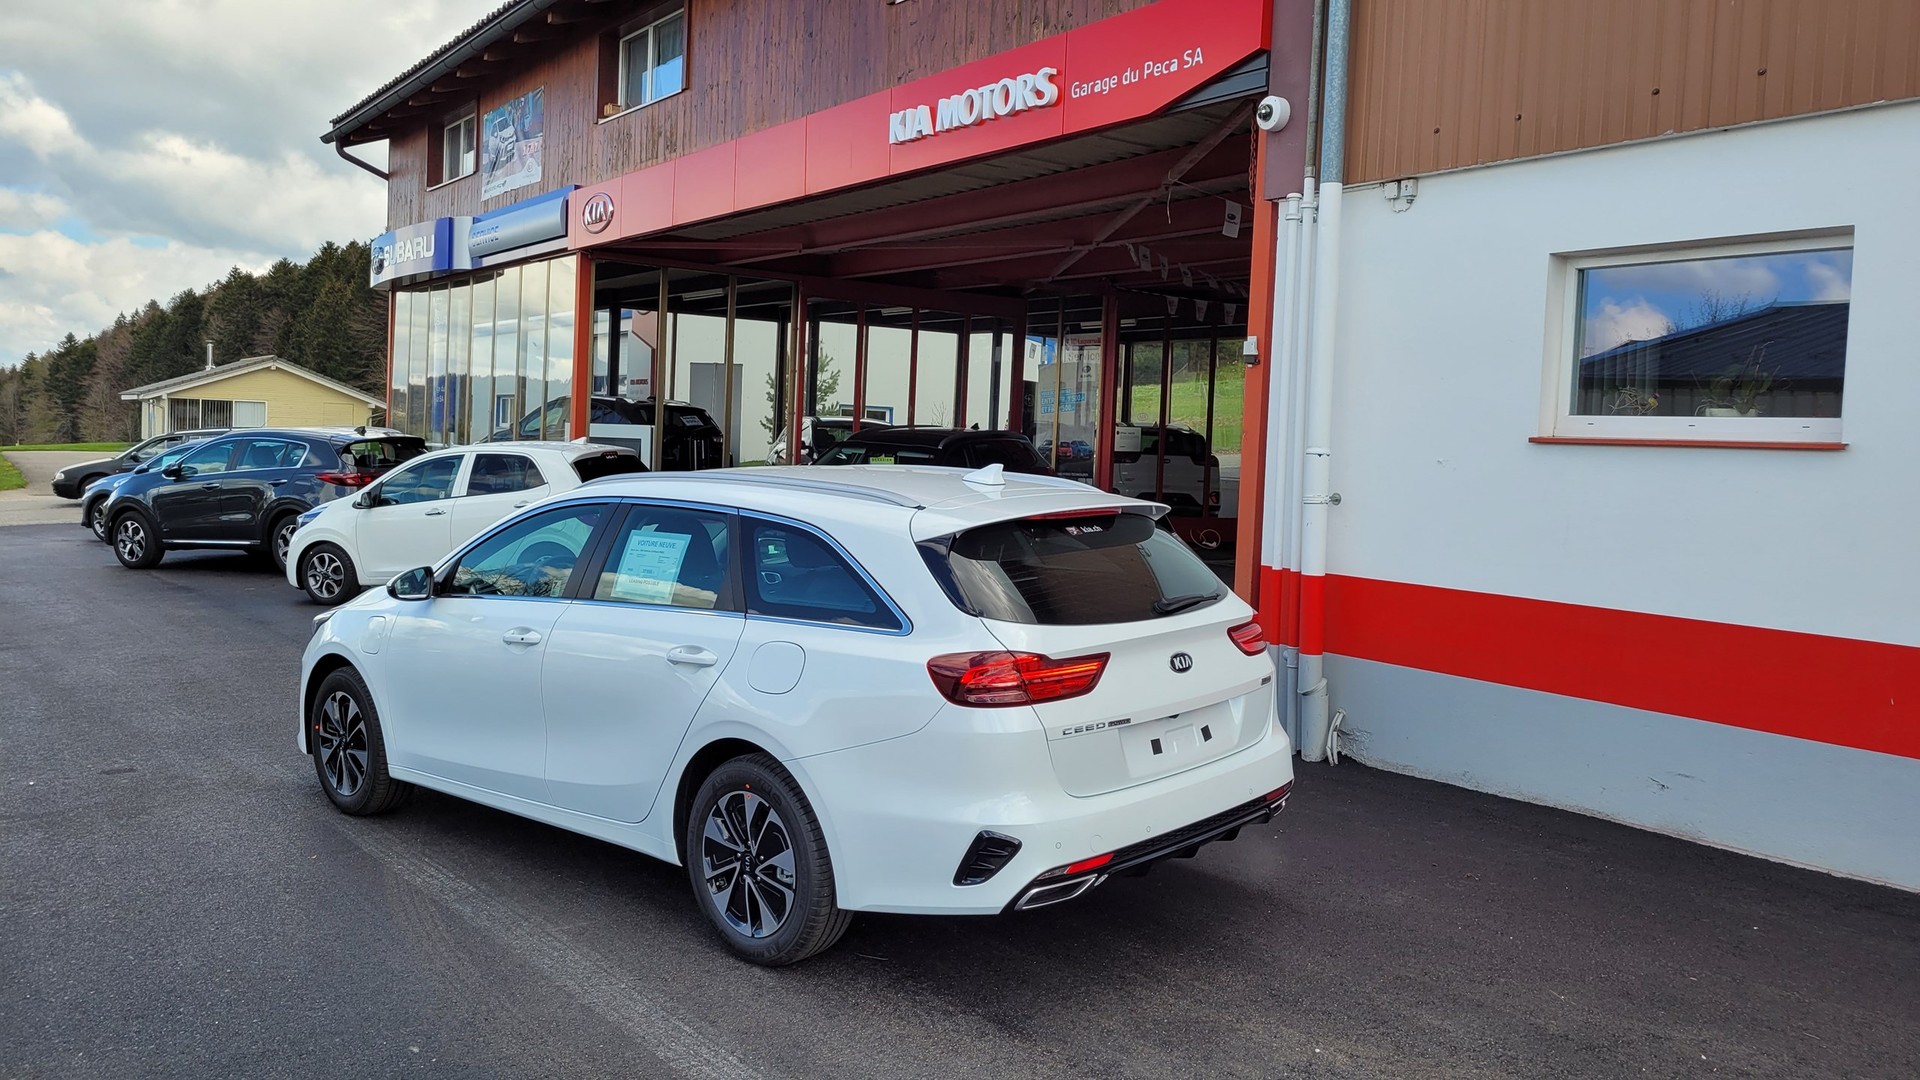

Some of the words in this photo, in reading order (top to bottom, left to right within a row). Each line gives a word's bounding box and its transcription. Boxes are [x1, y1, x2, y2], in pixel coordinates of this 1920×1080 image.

[1071, 73, 1118, 99] Garage
[1122, 66, 1139, 84] du
[1143, 57, 1179, 80] Peca
[1183, 46, 1204, 69] SA
[889, 104, 934, 145] KIA
[935, 66, 1058, 132] MOTORS
[585, 200, 607, 226] KIA
[383, 233, 436, 268] SUBARU
[637, 539, 659, 548] VOITURE
[659, 541, 677, 549] NEUVE
[1173, 655, 1192, 670] KIA
[1062, 721, 1106, 736] CEED
